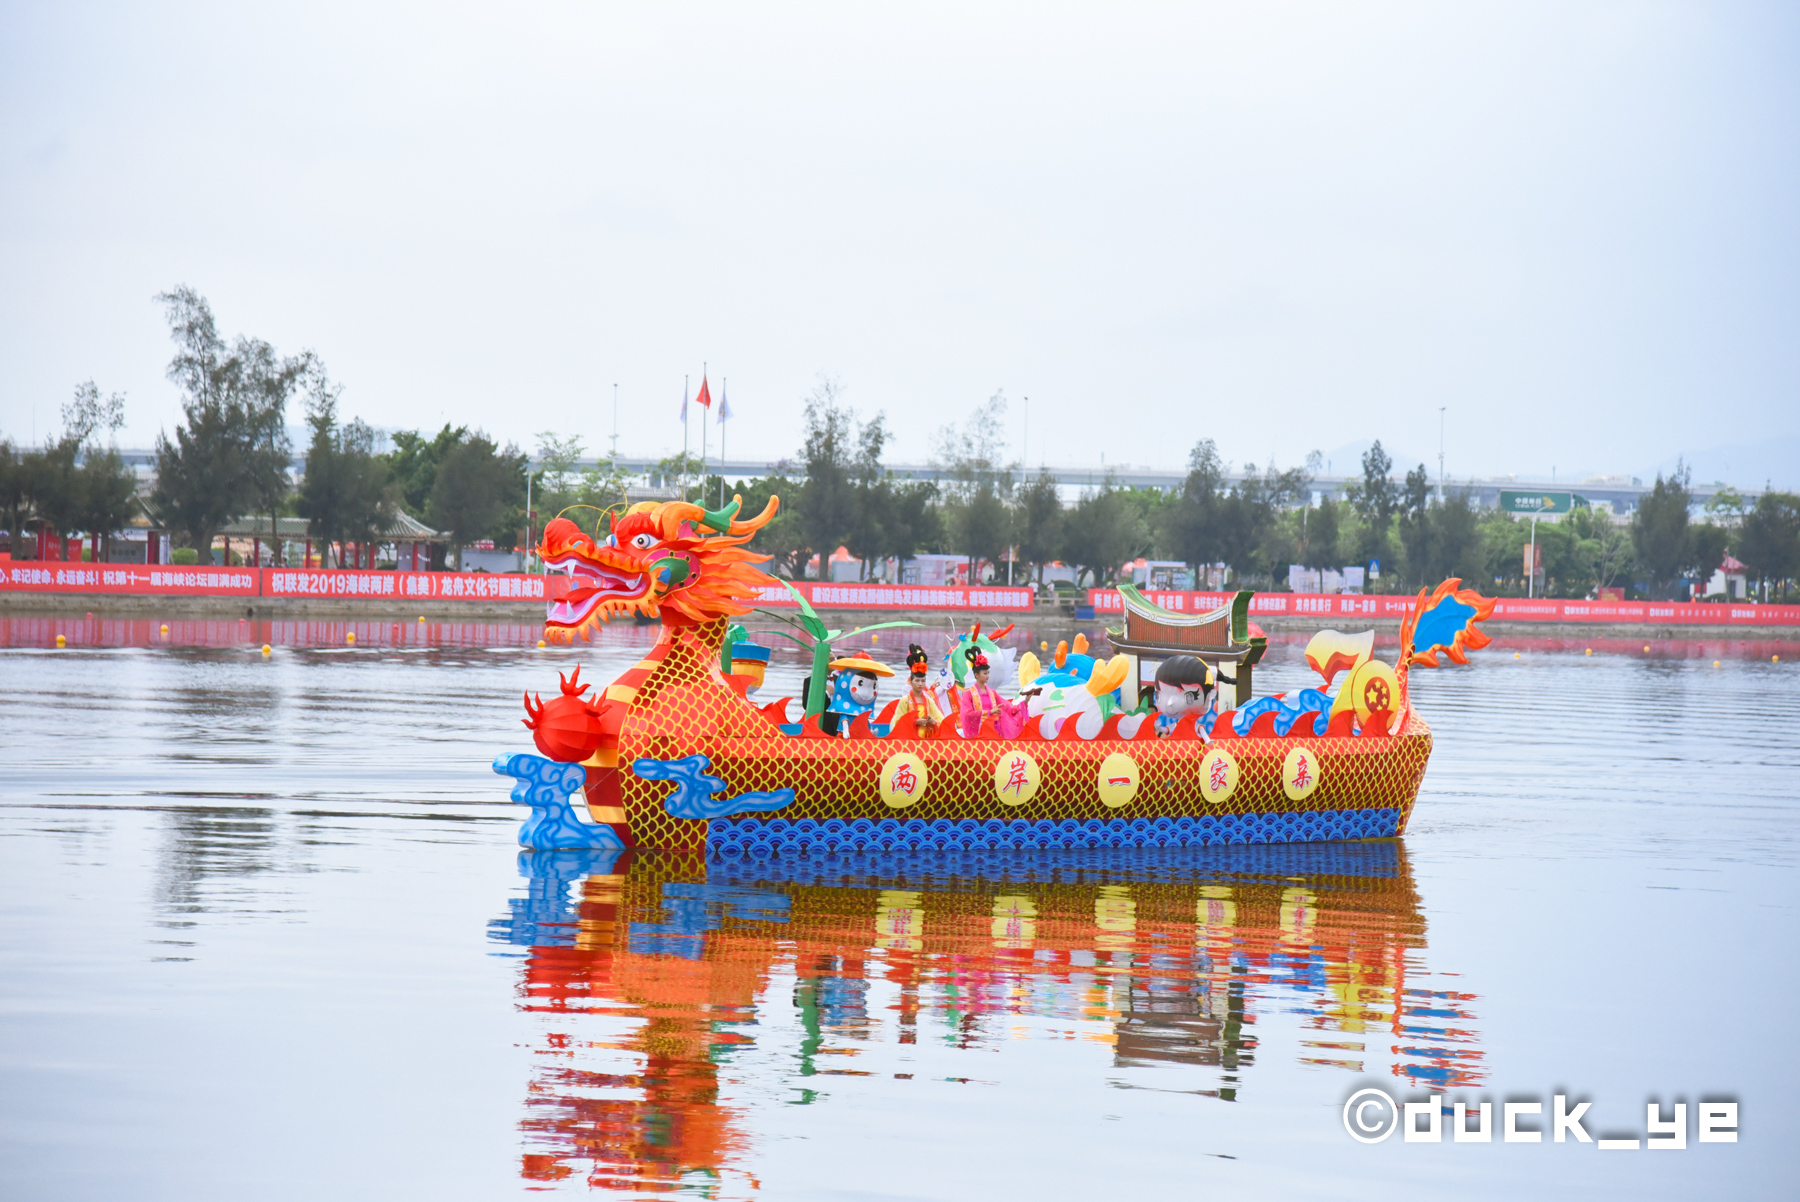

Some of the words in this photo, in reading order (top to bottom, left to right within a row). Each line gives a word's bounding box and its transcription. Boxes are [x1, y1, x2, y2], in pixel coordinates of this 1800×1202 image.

[103, 569, 252, 588] 祝第十一届海峡论坛圆满成功
[271, 572, 544, 598] 祝联发2019海峡两岸（集美）龙舟文化节圆满成功
